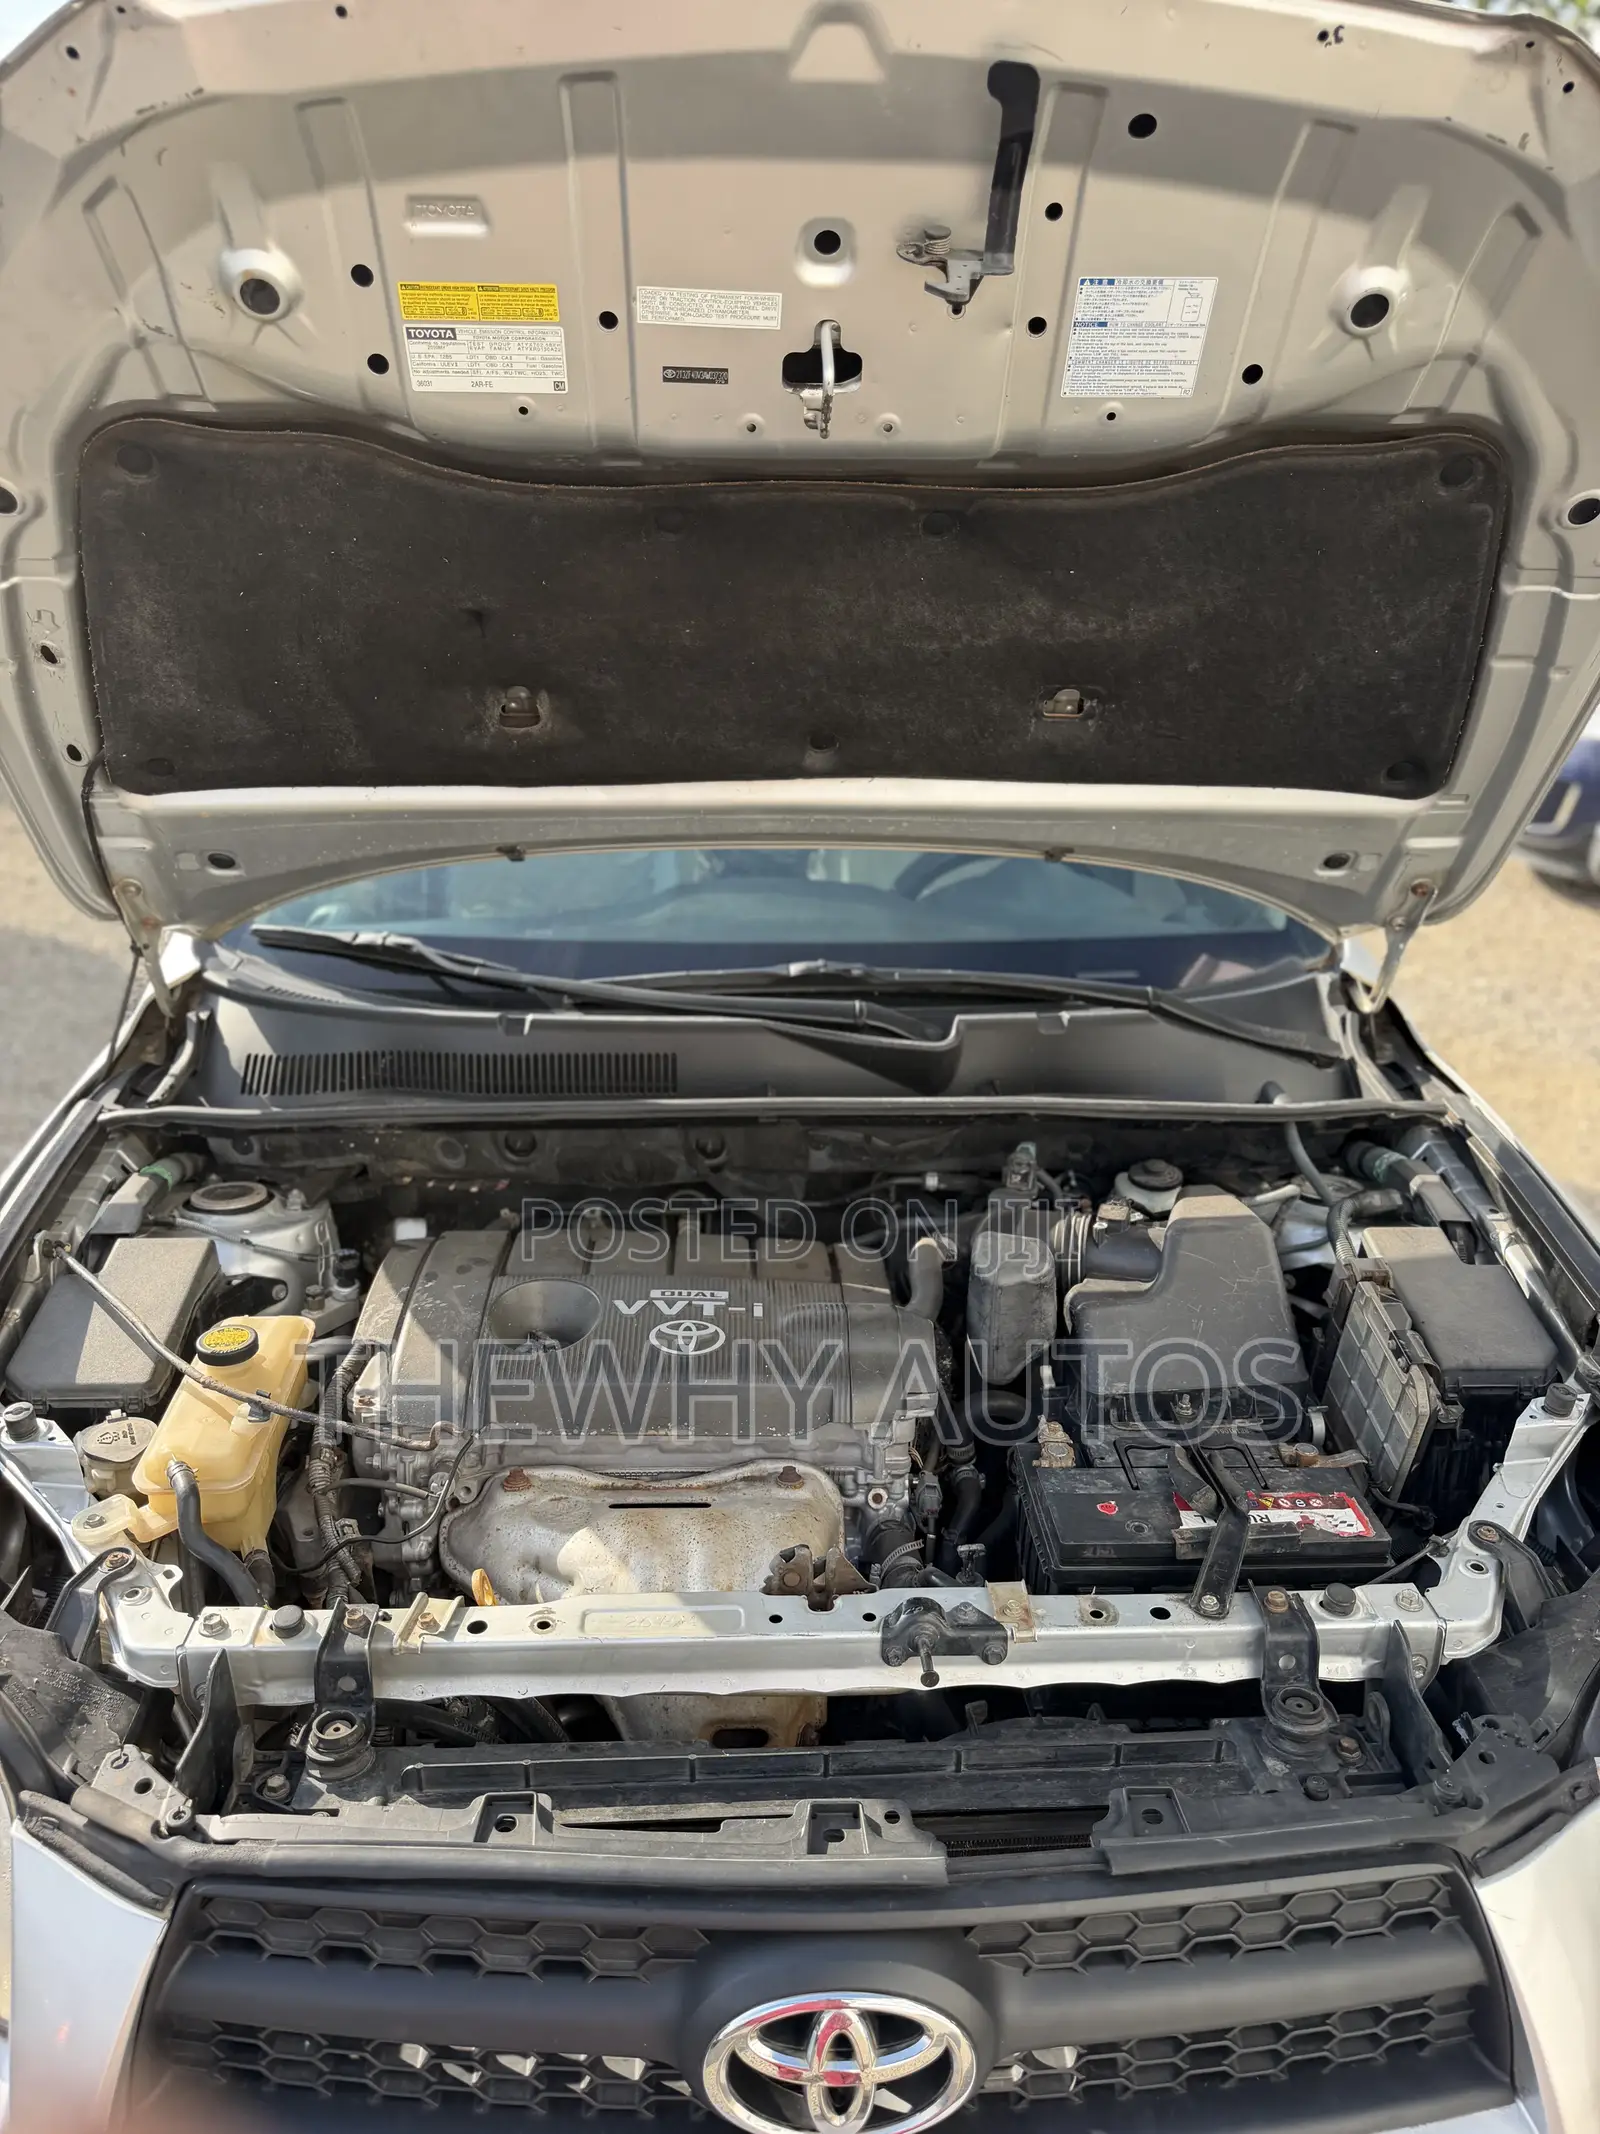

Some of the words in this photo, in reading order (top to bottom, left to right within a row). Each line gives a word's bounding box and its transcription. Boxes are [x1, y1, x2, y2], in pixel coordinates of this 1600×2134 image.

[408, 329, 454, 339] TOYOTA
[554, 381, 565, 390] CM
[660, 1290, 722, 1298] DUAL
[612, 1300, 764, 1317] VVT-i
